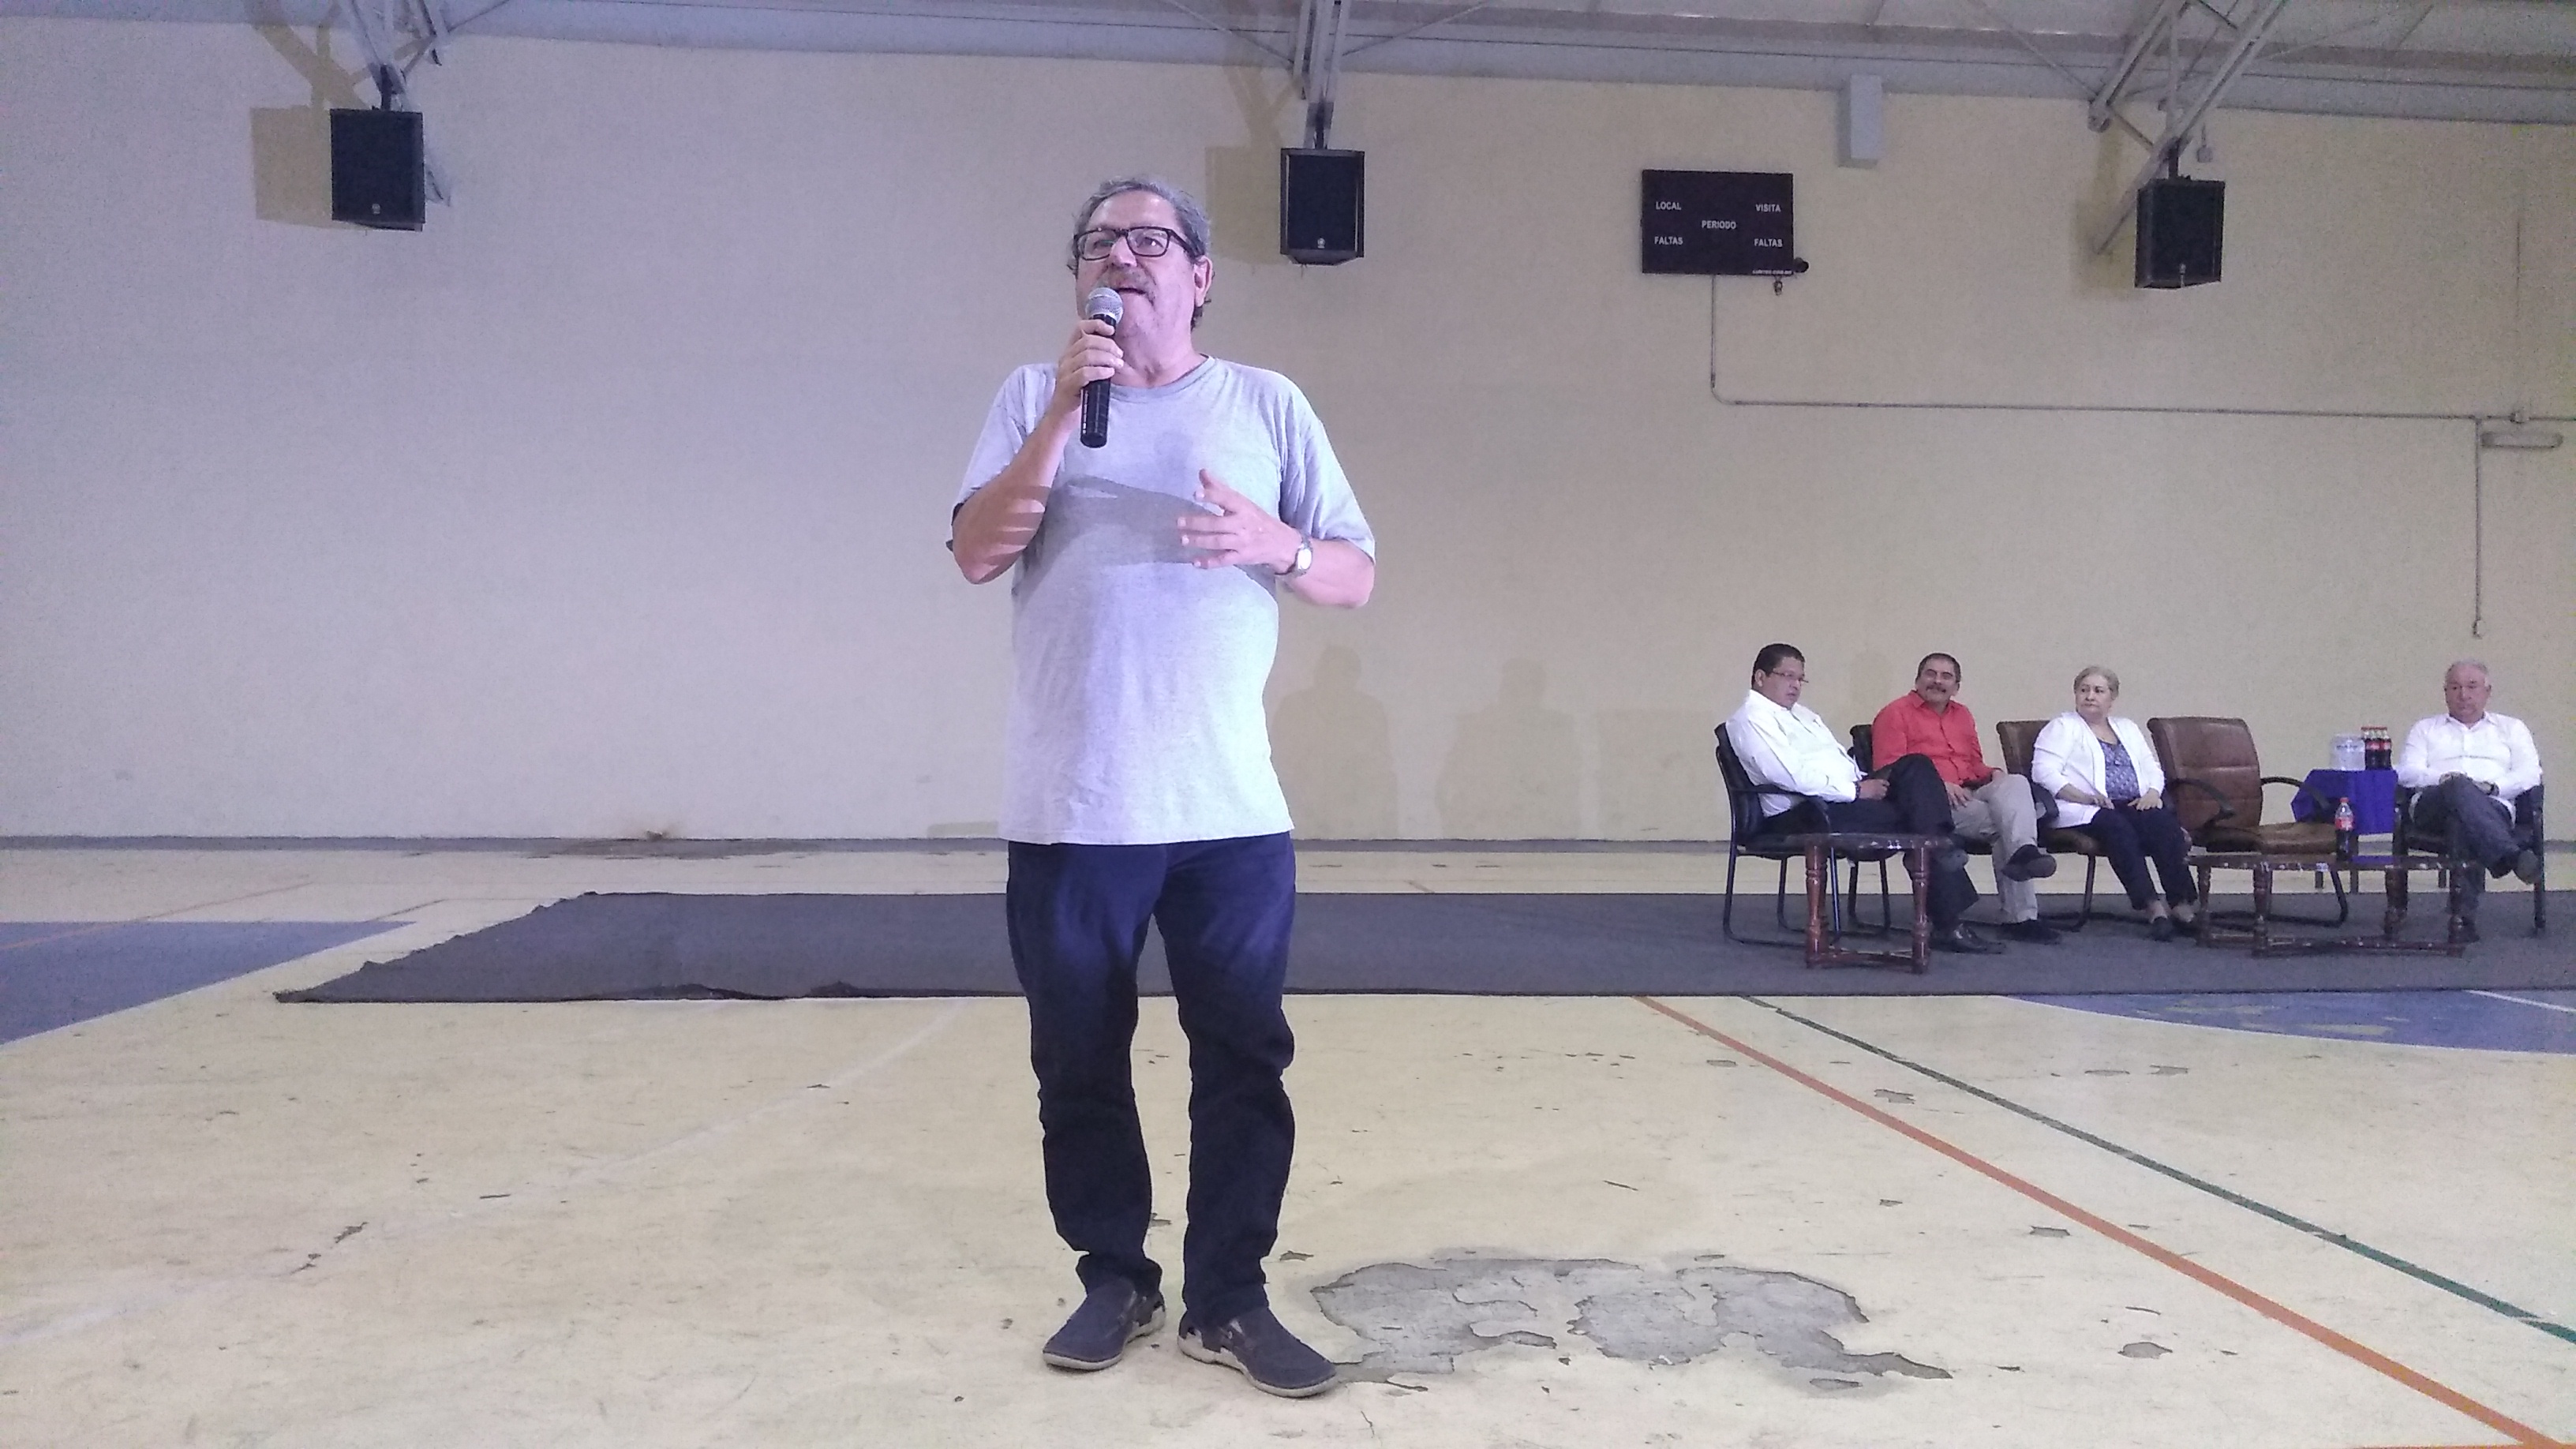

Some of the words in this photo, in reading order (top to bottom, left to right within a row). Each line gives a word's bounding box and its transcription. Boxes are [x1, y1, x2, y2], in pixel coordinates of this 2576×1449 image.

[1656, 201, 1682, 211] LOCAL
[1755, 204, 1781, 212] VISITA
[1702, 220, 1737, 230] PERIODO
[1654, 236, 1683, 245] FALTAS
[1754, 238, 1783, 247] FALTAS
